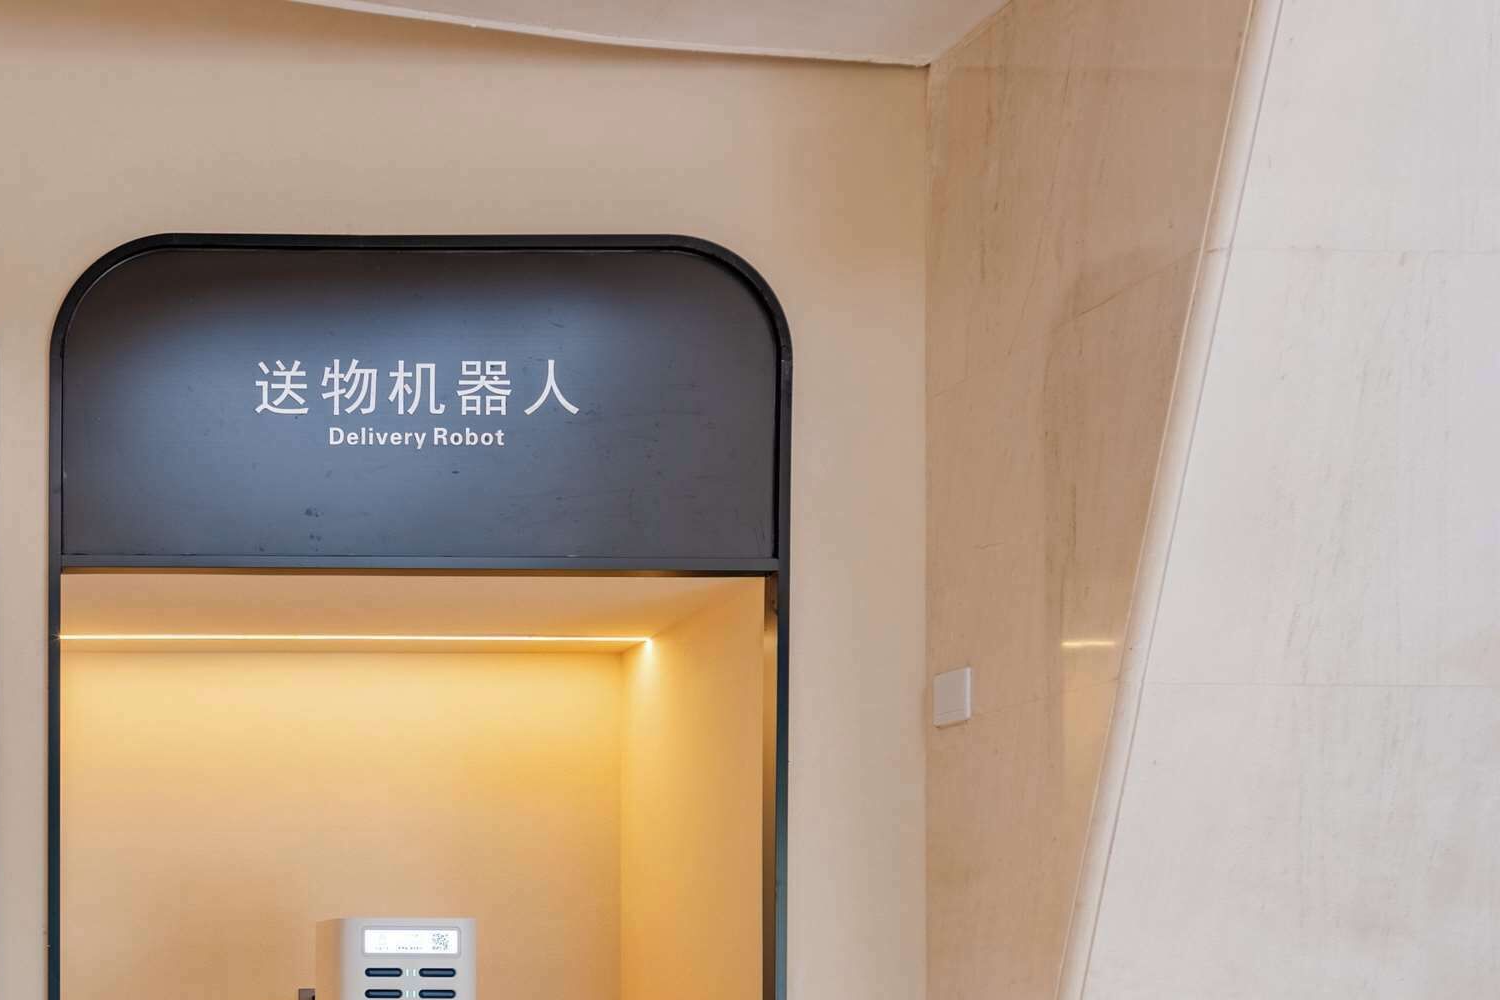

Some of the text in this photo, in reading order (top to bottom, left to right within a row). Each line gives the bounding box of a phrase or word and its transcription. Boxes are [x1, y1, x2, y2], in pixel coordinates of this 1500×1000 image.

[253, 358, 581, 416] 送物机器人
[328, 427, 506, 450] Delivery Robot
